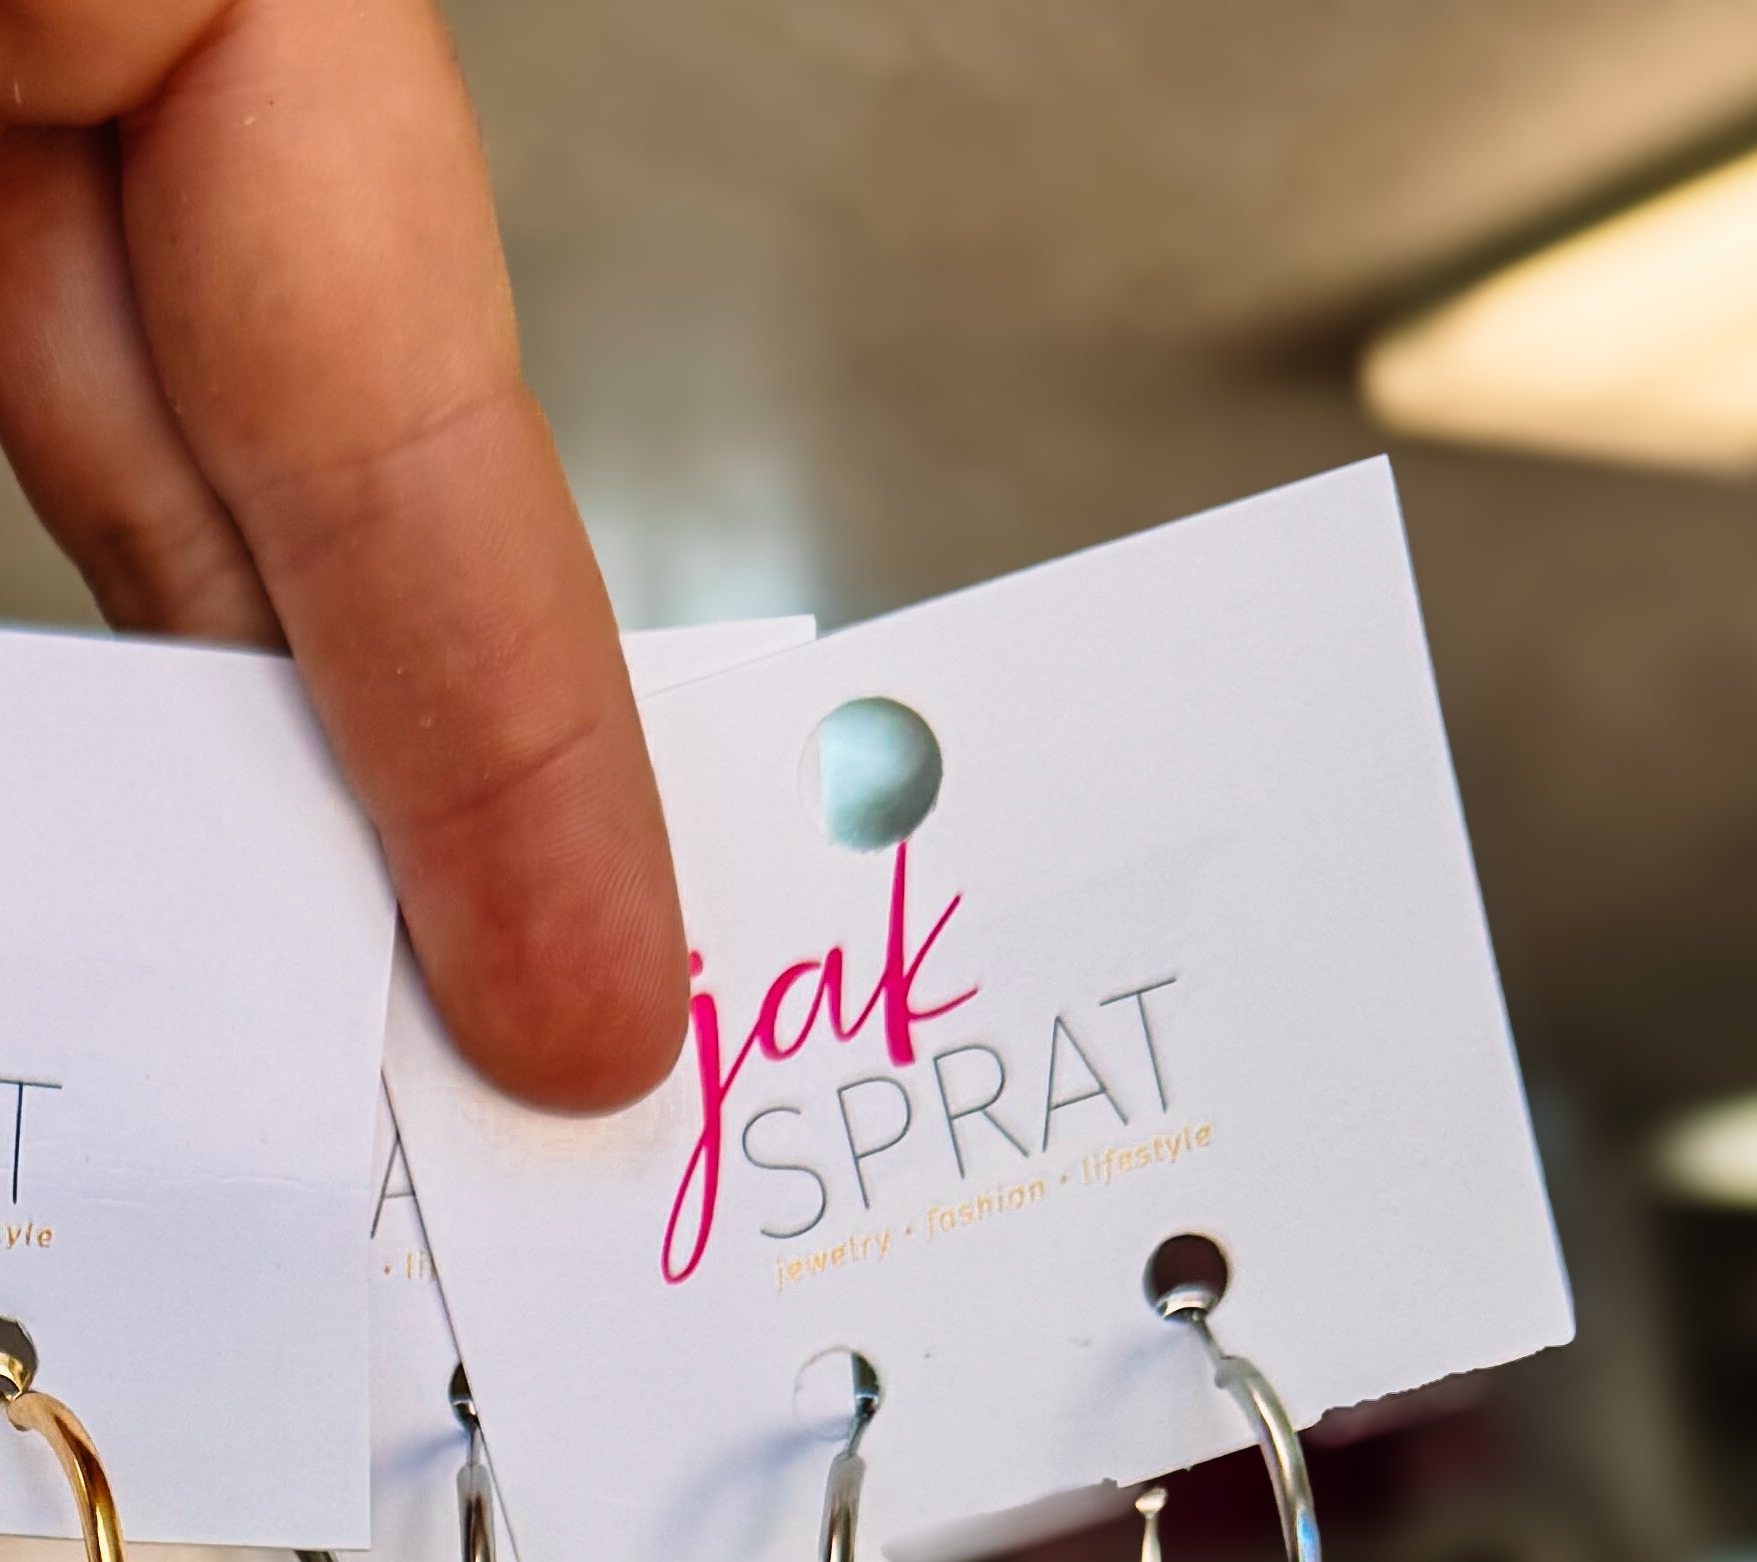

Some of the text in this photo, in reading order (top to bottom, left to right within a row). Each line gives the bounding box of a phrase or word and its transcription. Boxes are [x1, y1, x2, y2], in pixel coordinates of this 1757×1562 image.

[661, 842, 980, 1285] jak
[741, 975, 1178, 1240] SPRAT
[774, 1121, 1215, 1293] jewelry fashion lifestyle
